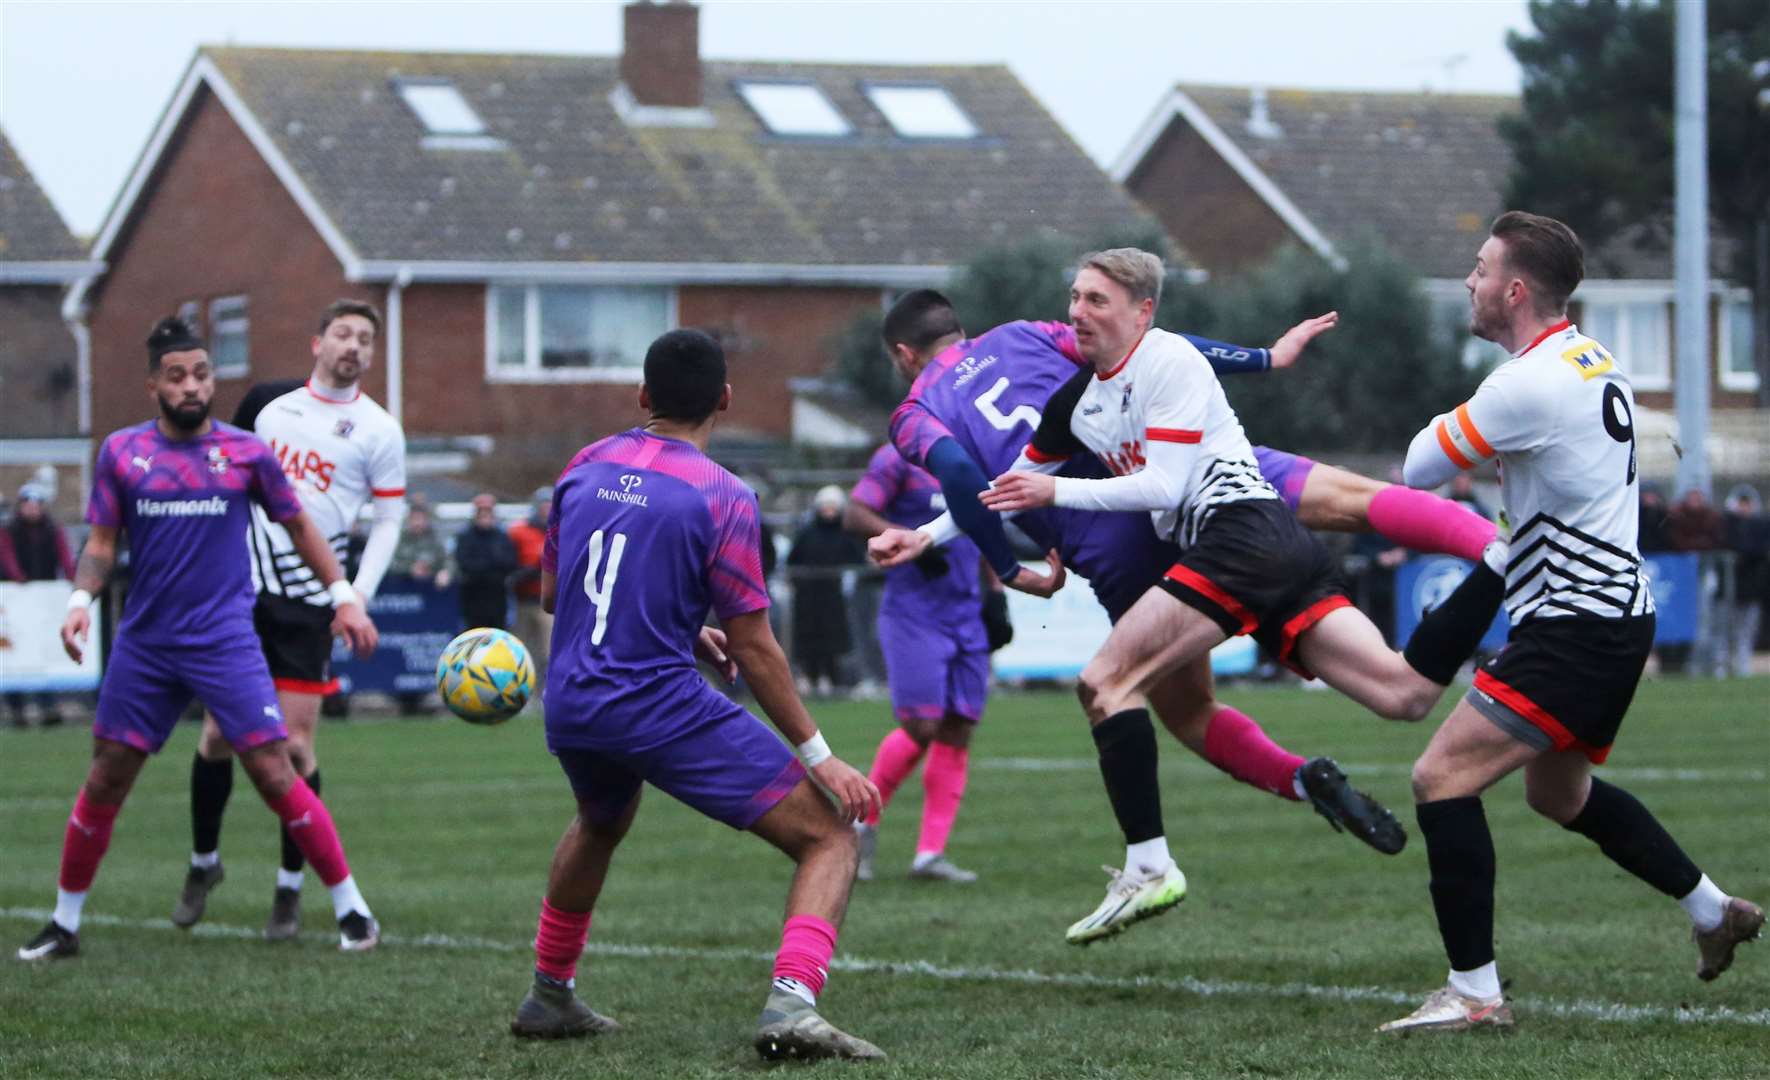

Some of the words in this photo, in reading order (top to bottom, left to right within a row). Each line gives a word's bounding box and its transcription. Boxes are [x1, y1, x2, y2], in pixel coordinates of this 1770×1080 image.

[974, 377, 1042, 431] 5
[1602, 382, 1637, 486] 9
[136, 496, 229, 516] Harmonix
[597, 488, 648, 507] PAINSHILL
[584, 530, 627, 646] 4
